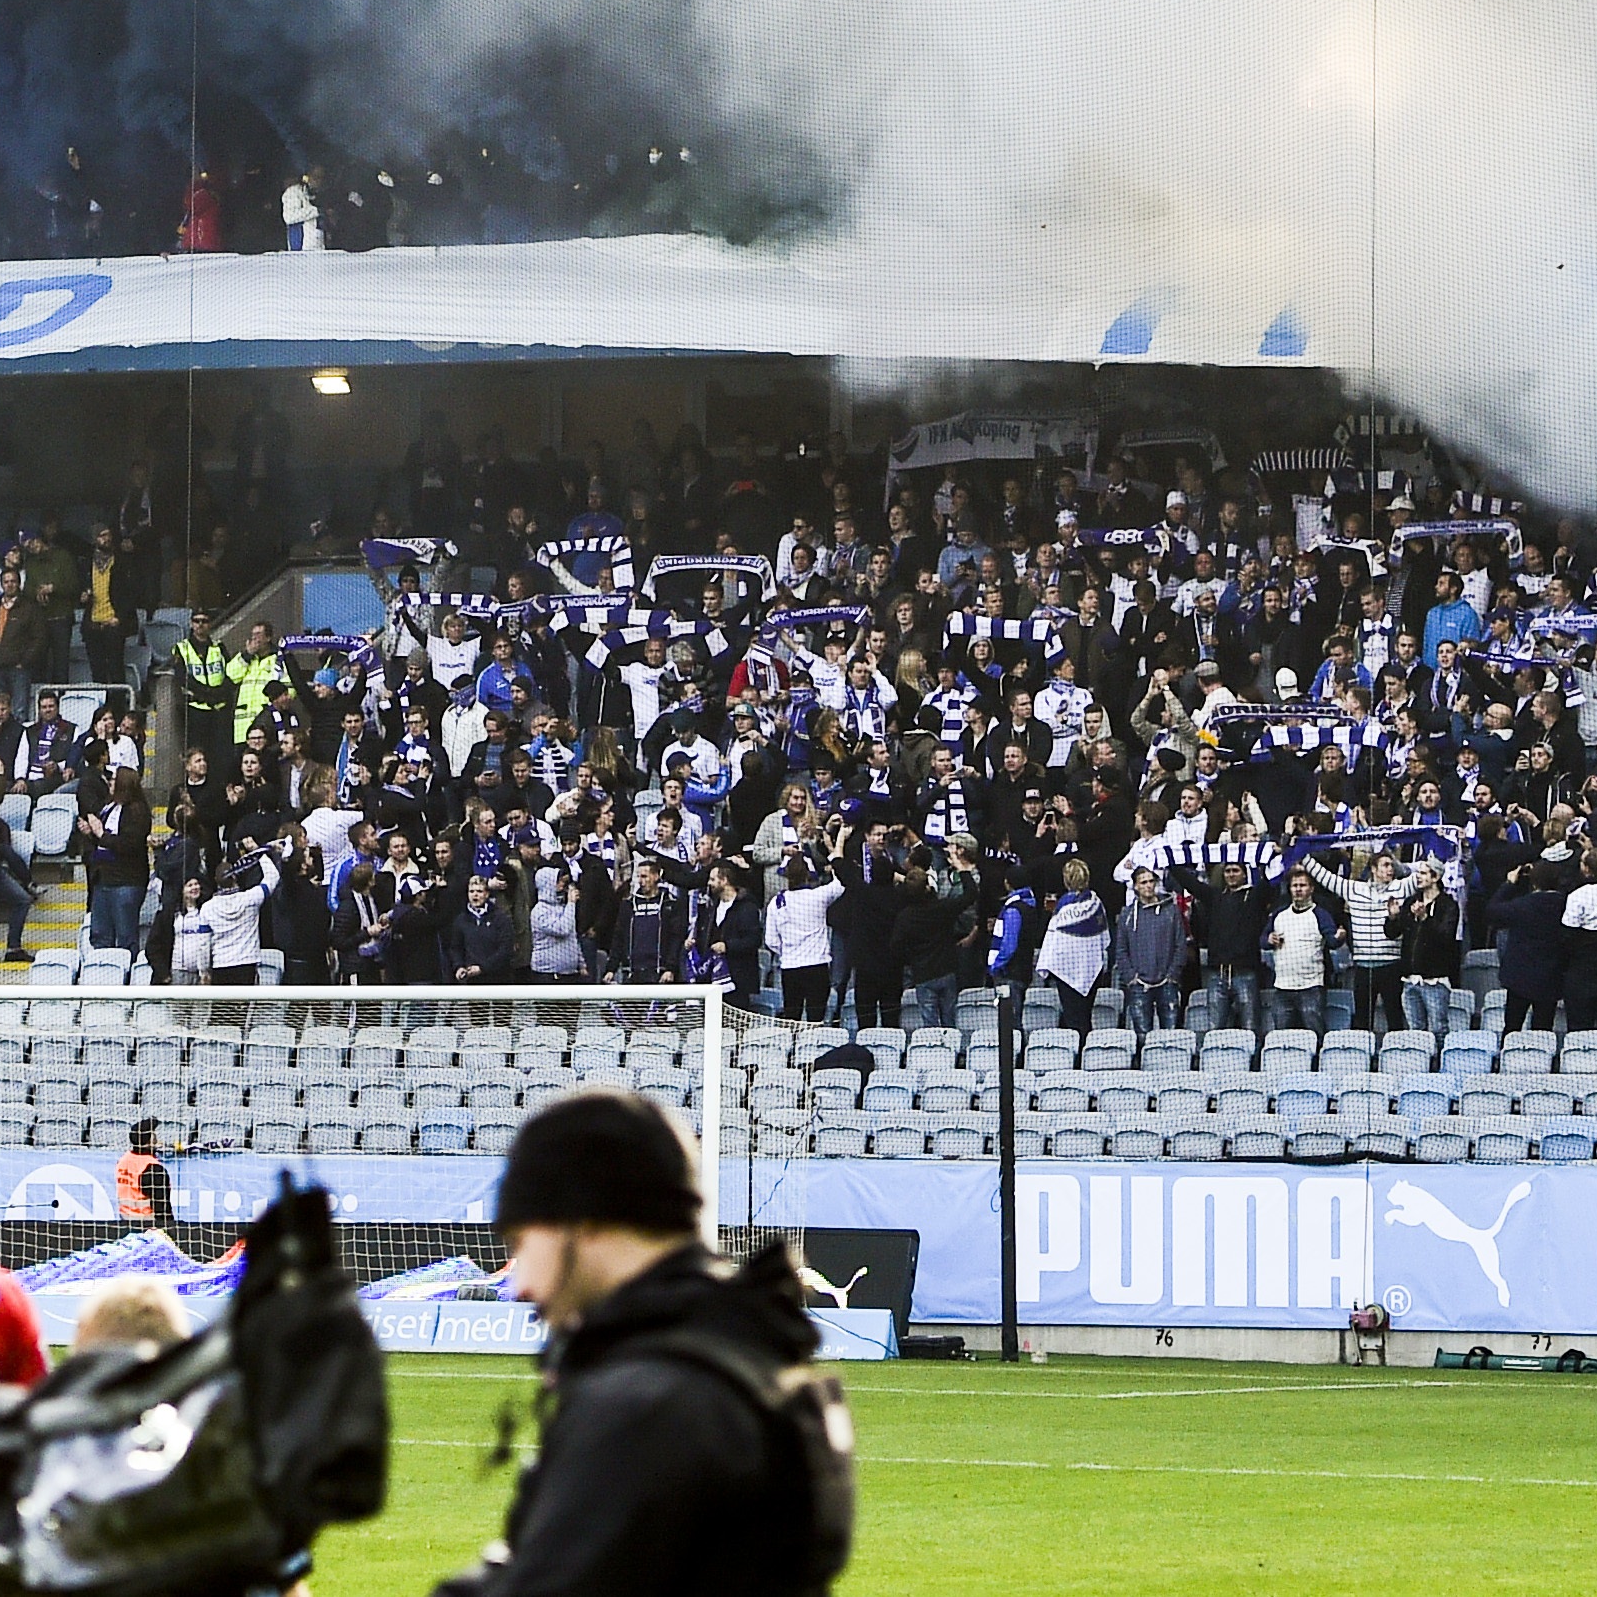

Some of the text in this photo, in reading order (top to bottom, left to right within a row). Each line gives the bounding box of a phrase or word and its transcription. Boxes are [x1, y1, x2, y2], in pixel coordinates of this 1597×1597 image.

[1014, 1175, 1376, 1308] PUMA
[439, 1305, 513, 1341] med
[1154, 1329, 1175, 1348] 76
